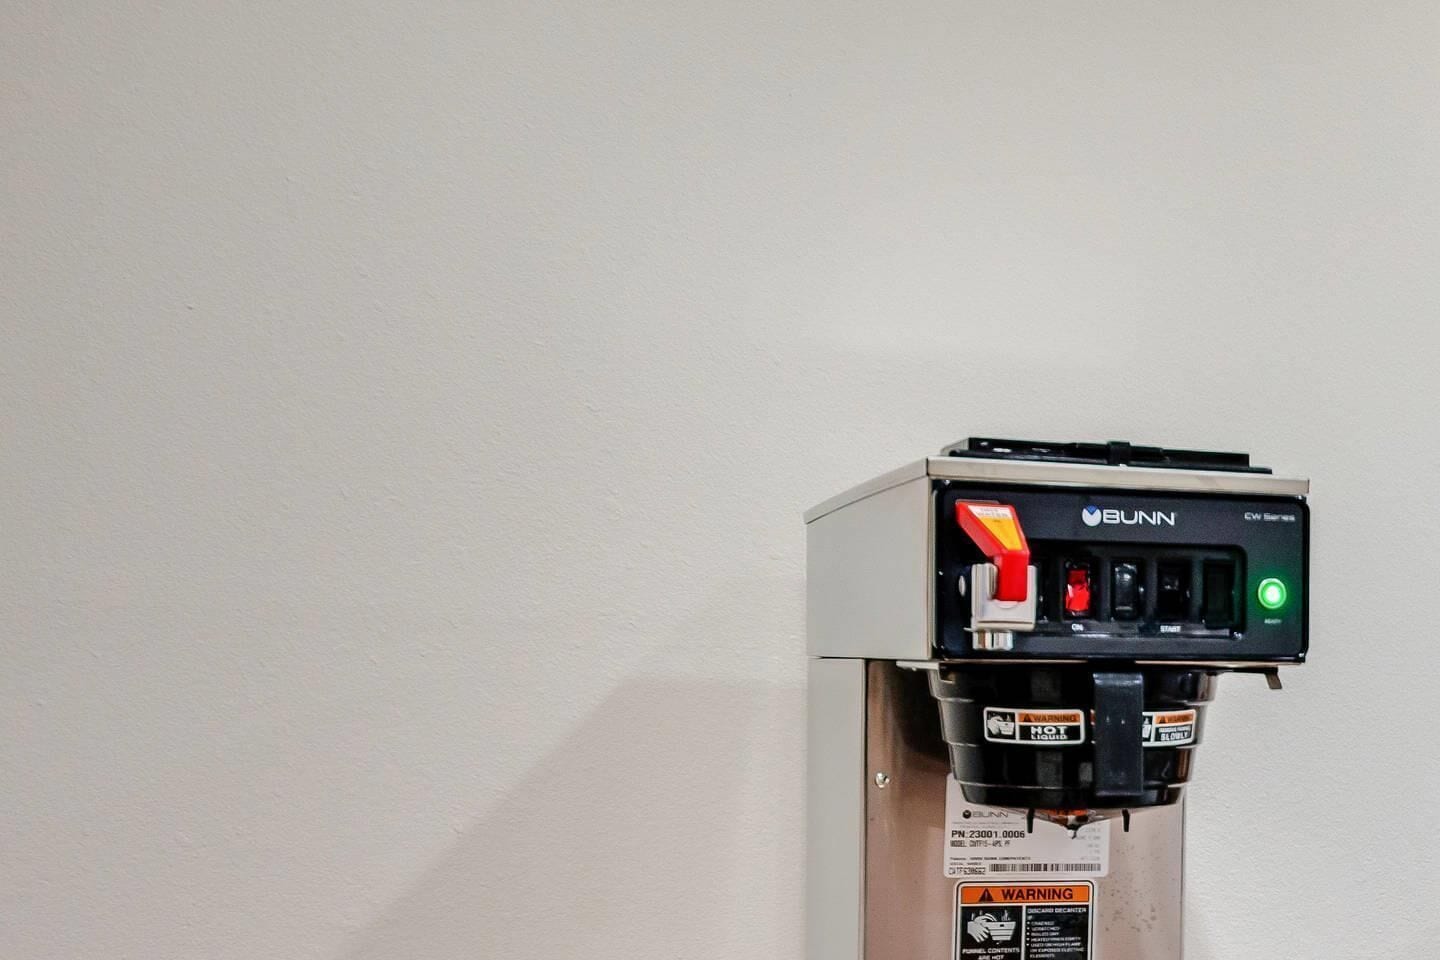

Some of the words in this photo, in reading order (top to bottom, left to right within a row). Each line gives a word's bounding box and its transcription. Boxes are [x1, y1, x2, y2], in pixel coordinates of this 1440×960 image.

[1102, 508, 1176, 526] BUNN
[1244, 512, 1262, 521] CW
[1263, 512, 1296, 522] Series
[1033, 714, 1077, 723] WARNING
[1030, 726, 1068, 735] HOT
[972, 811, 1009, 819] BUNN
[1001, 888, 1074, 901] WARNING
